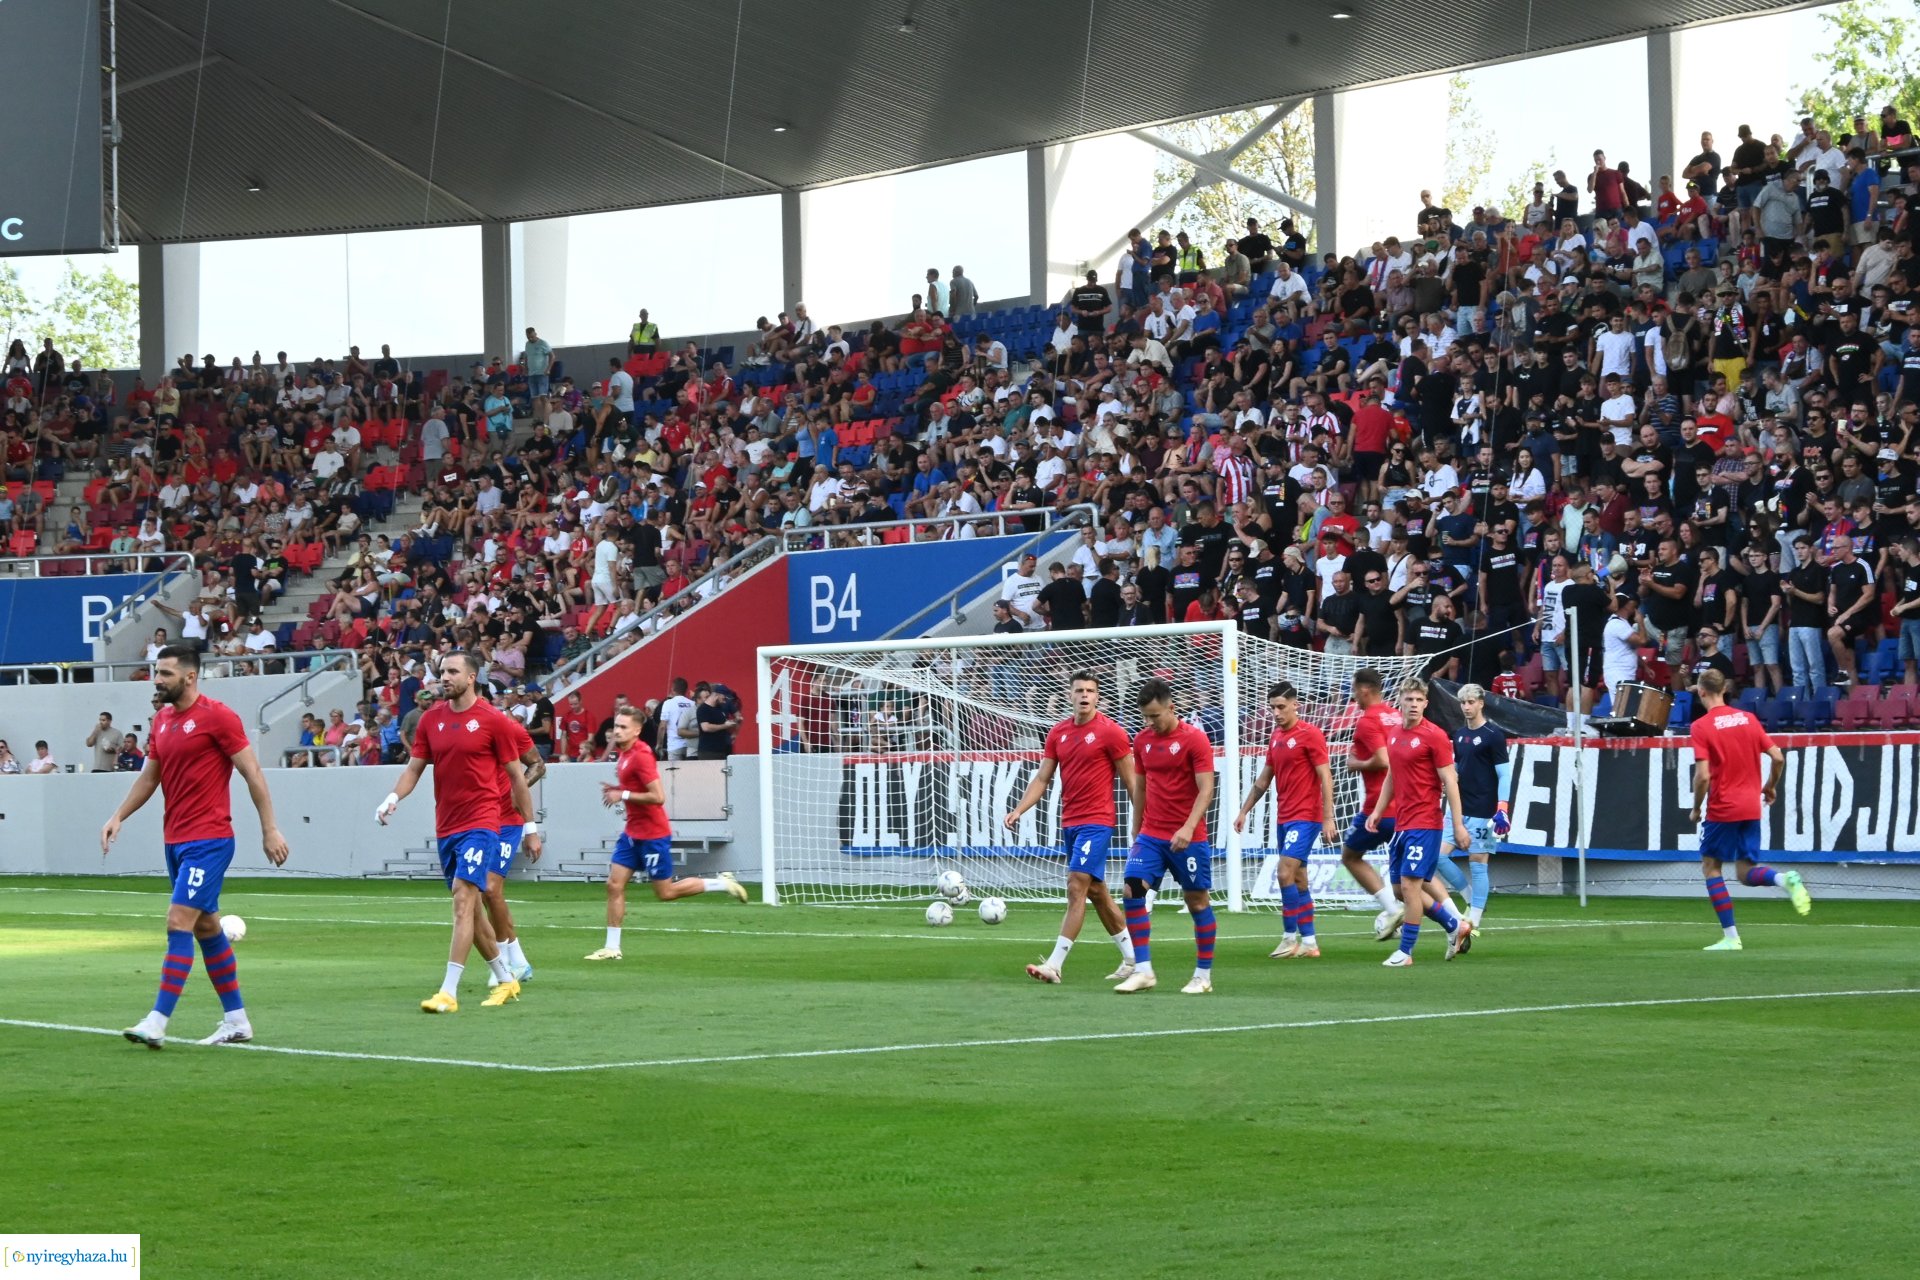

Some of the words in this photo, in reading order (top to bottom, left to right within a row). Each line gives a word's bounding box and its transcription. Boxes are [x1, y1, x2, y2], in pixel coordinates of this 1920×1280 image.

[811, 573, 861, 634] B4
[1541, 591, 1559, 631] JEANS
[852, 762, 922, 847] OLY
[1475, 827, 1488, 840] 32
[463, 847, 483, 866] 44
[500, 842, 512, 859] 19
[1081, 840, 1091, 855] 4
[1407, 845, 1423, 860] 23
[1187, 856, 1198, 872] 6
[188, 866, 206, 887] 13
